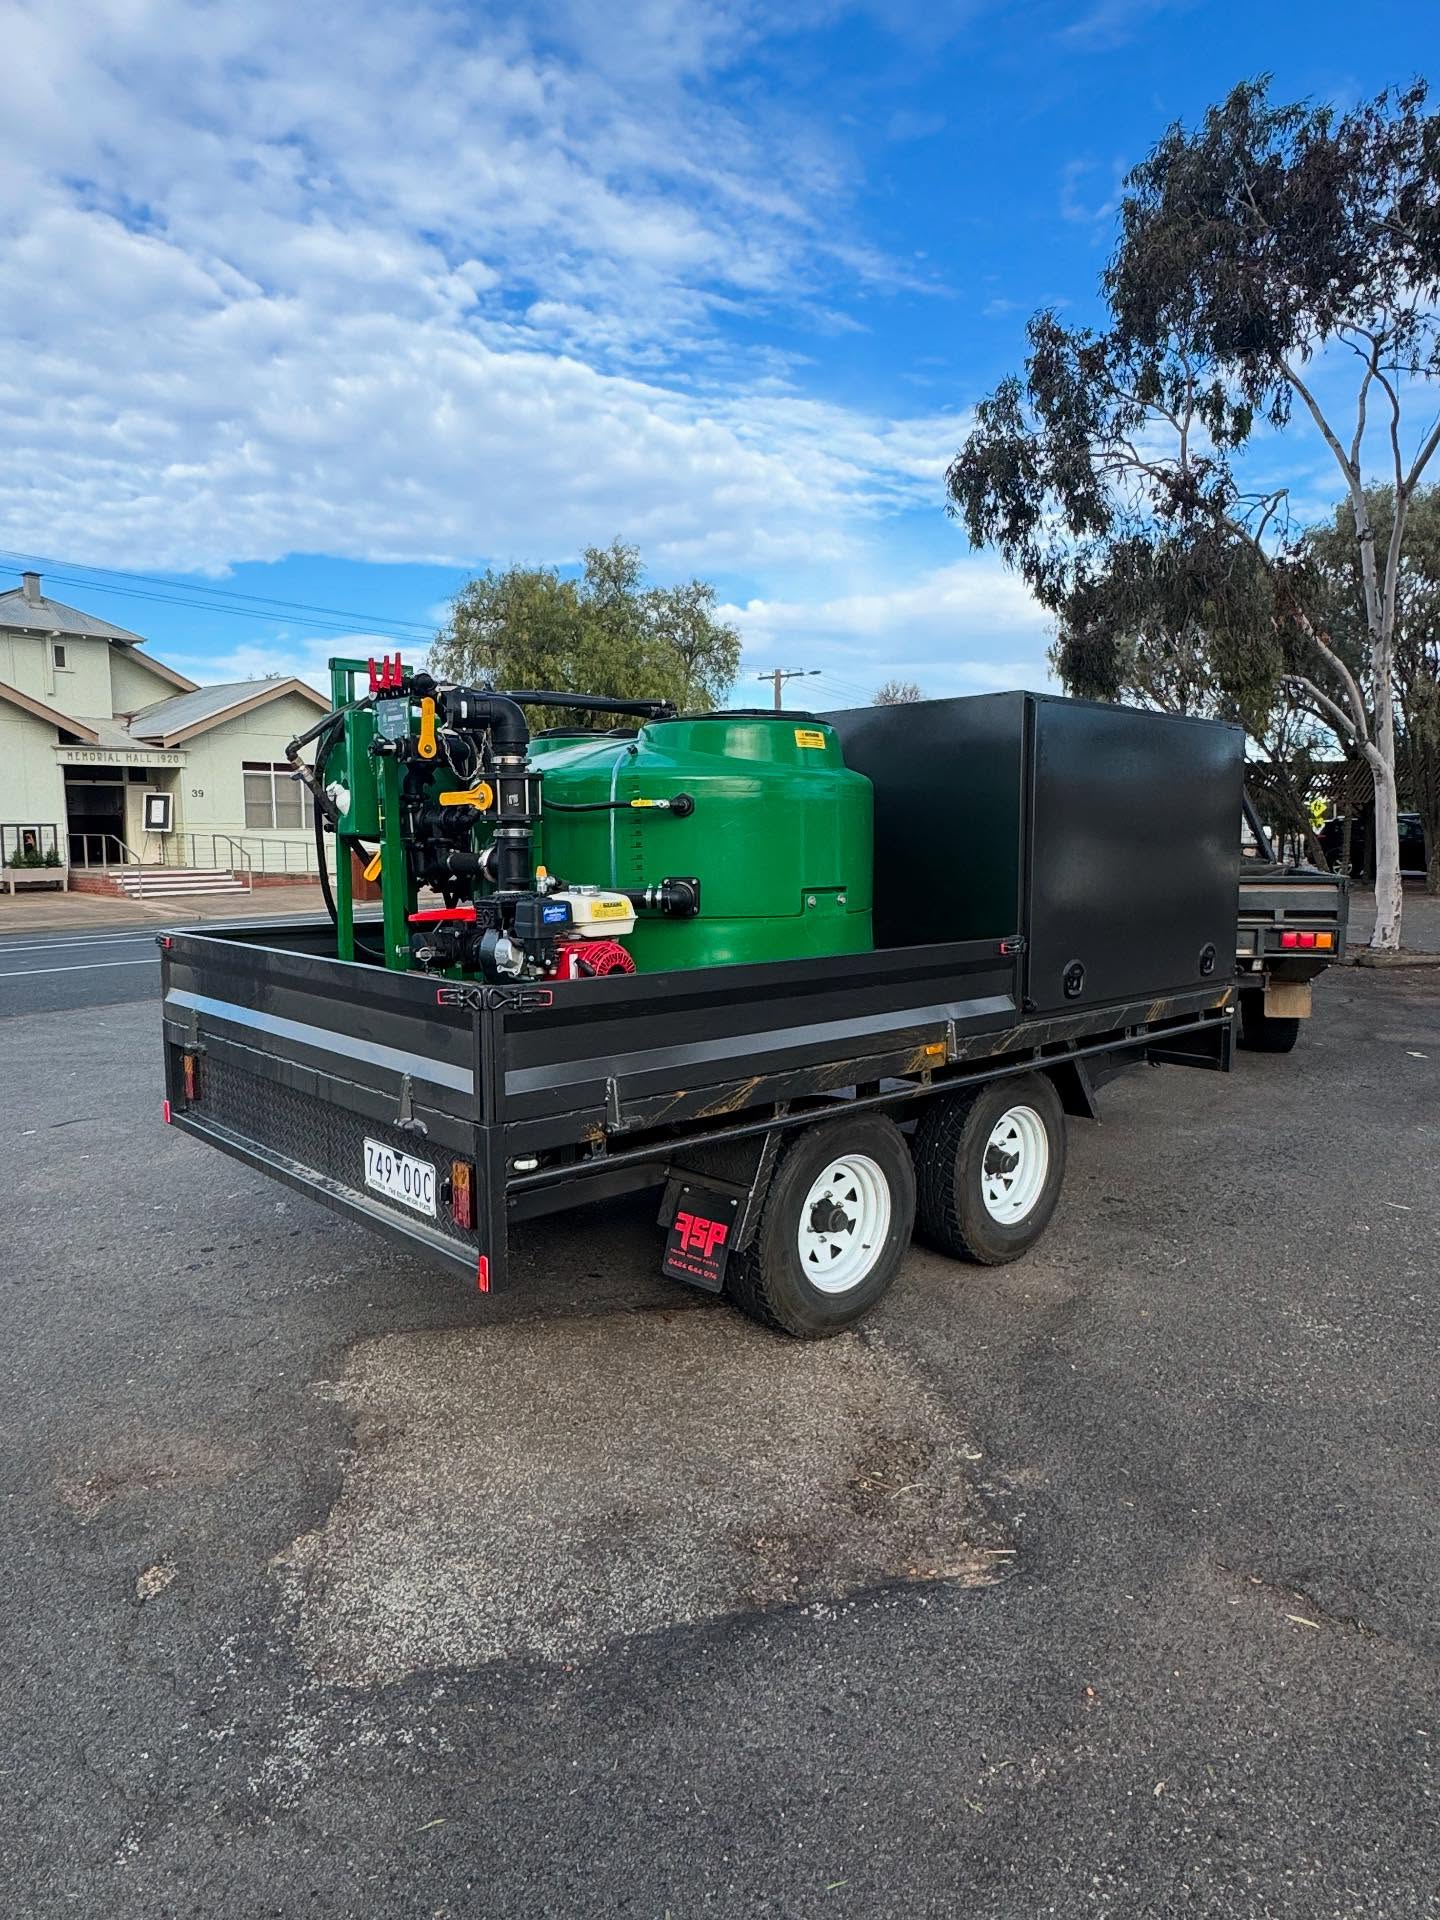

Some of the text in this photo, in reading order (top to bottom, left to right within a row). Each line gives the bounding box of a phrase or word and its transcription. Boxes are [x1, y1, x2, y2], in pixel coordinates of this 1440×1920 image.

[67, 751, 179, 764] MEMORIAL HALL 1920
[191, 789, 204, 798] 39
[367, 1147, 392, 1183] 749
